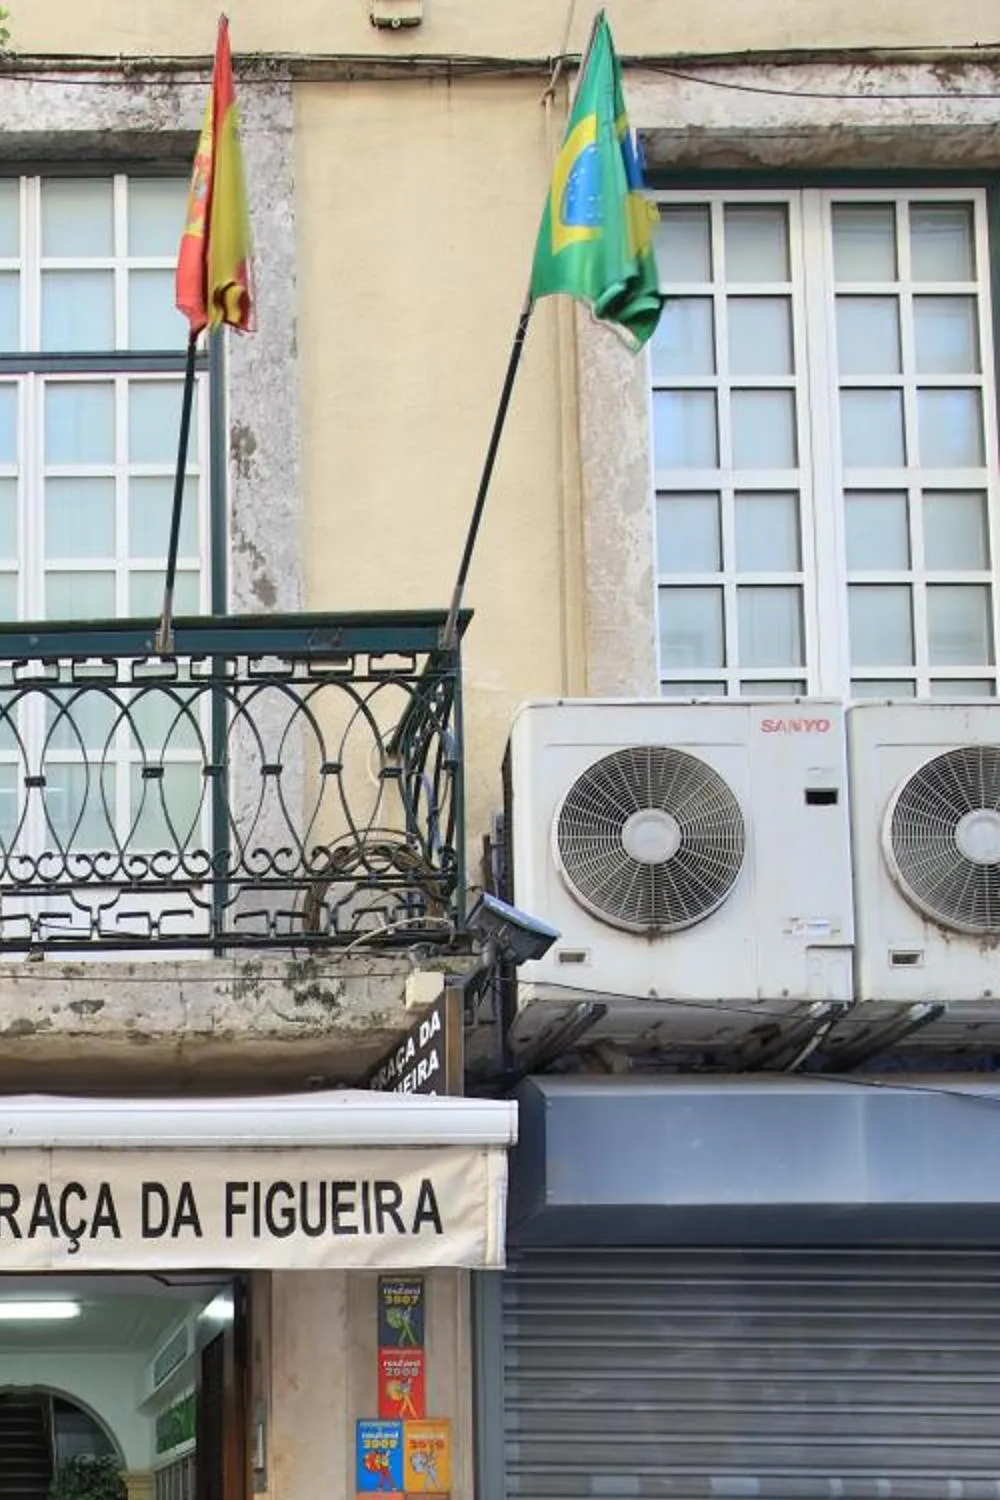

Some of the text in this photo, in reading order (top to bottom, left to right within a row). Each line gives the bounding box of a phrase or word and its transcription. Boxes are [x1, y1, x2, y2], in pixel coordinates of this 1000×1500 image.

[760, 719, 830, 733] SANYO
[419, 1010, 441, 1048] DA
[141, 1181, 203, 1238] DA
[225, 1178, 443, 1238] FIGUEIRA
